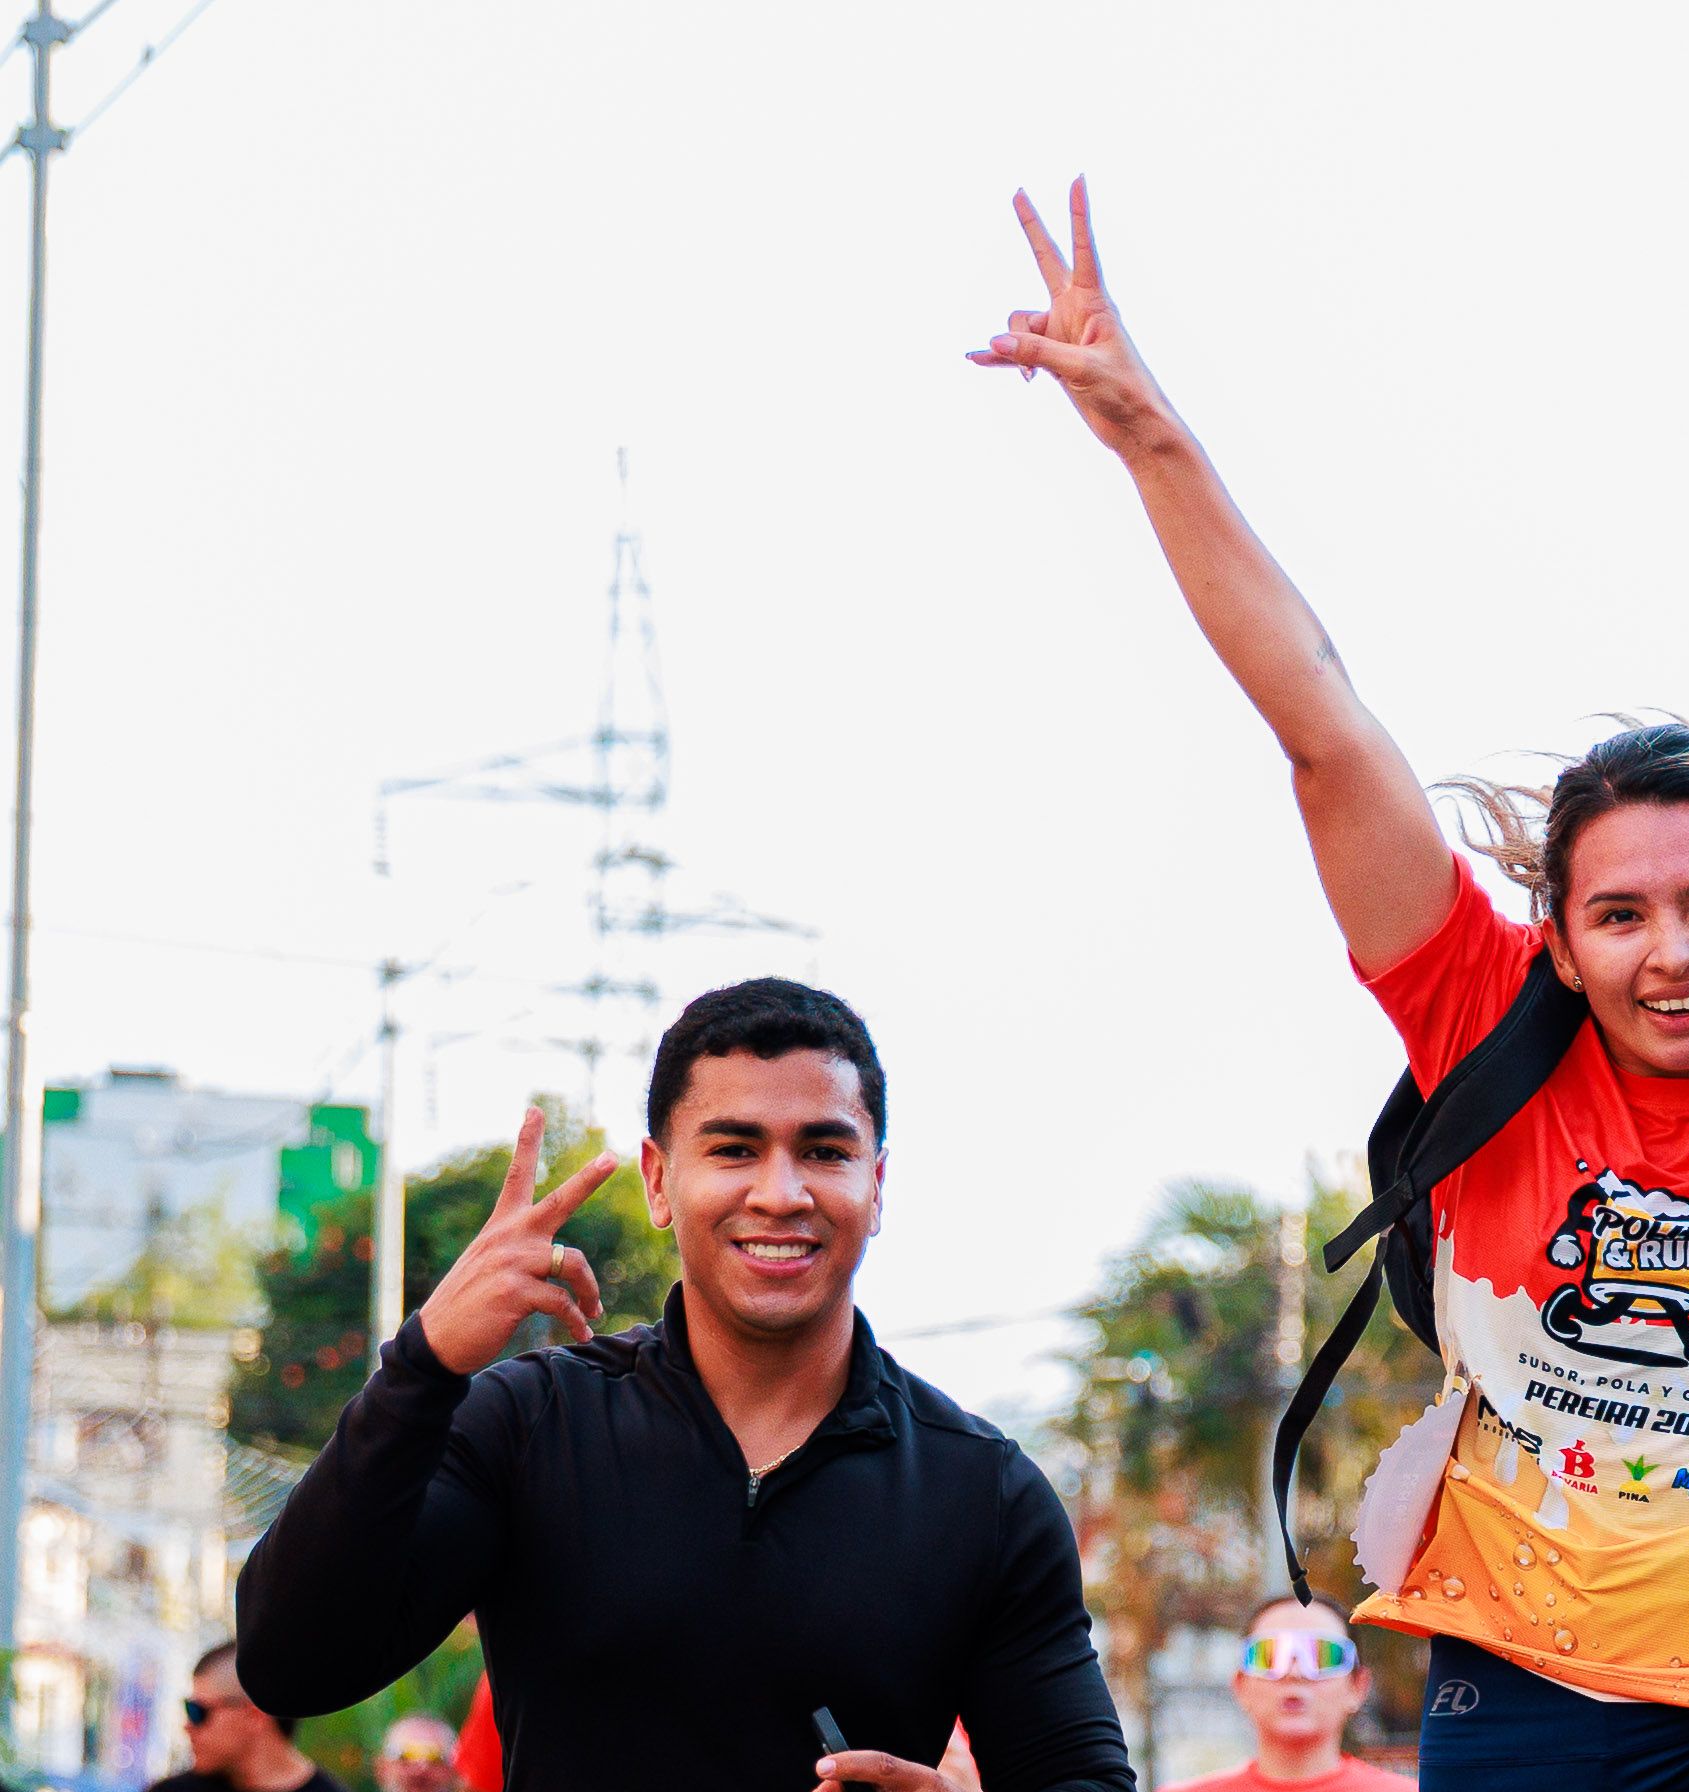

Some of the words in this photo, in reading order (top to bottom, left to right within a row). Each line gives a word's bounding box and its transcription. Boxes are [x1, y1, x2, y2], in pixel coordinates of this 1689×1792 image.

[1604, 1239, 1634, 1269] &
[1518, 1352, 1586, 1385] SUDOR,
[1597, 1376, 1650, 1395] POLA
[1662, 1385, 1673, 1398] Y
[1524, 1379, 1651, 1429] PEREIRA
